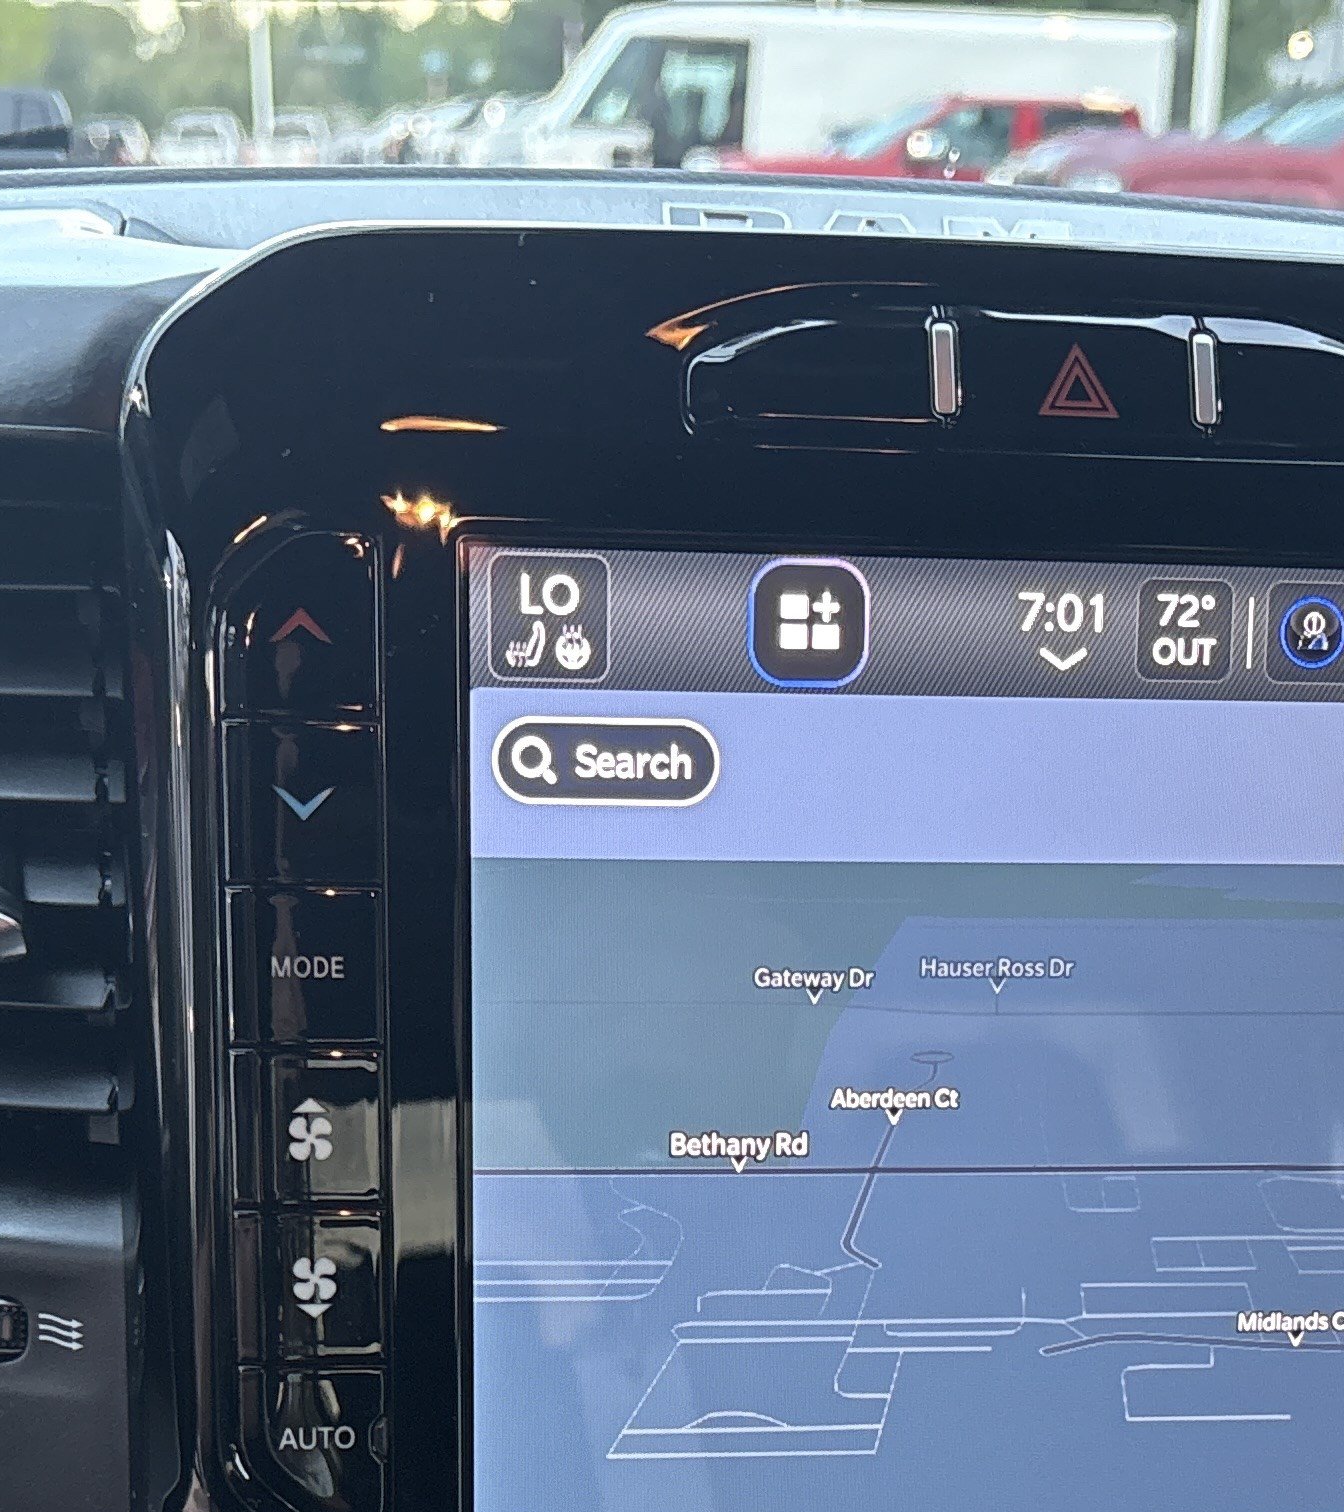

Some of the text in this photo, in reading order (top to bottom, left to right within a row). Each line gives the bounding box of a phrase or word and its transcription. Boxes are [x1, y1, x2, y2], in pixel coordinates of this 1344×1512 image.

[520, 572, 581, 616] LO
[1018, 592, 1106, 635] 7:01
[1152, 636, 1217, 667] OUT
[574, 743, 693, 781] Search
[270, 956, 345, 979] MODE
[920, 958, 1074, 978] Hauser Ross Dr
[753, 968, 874, 992] Gateway Dr
[830, 1089, 959, 1109] Aberdeen Ct
[668, 1132, 809, 1160] Bethany Rd
[1237, 1312, 1328, 1332] Midlands
[279, 1427, 356, 1450] AUTO
